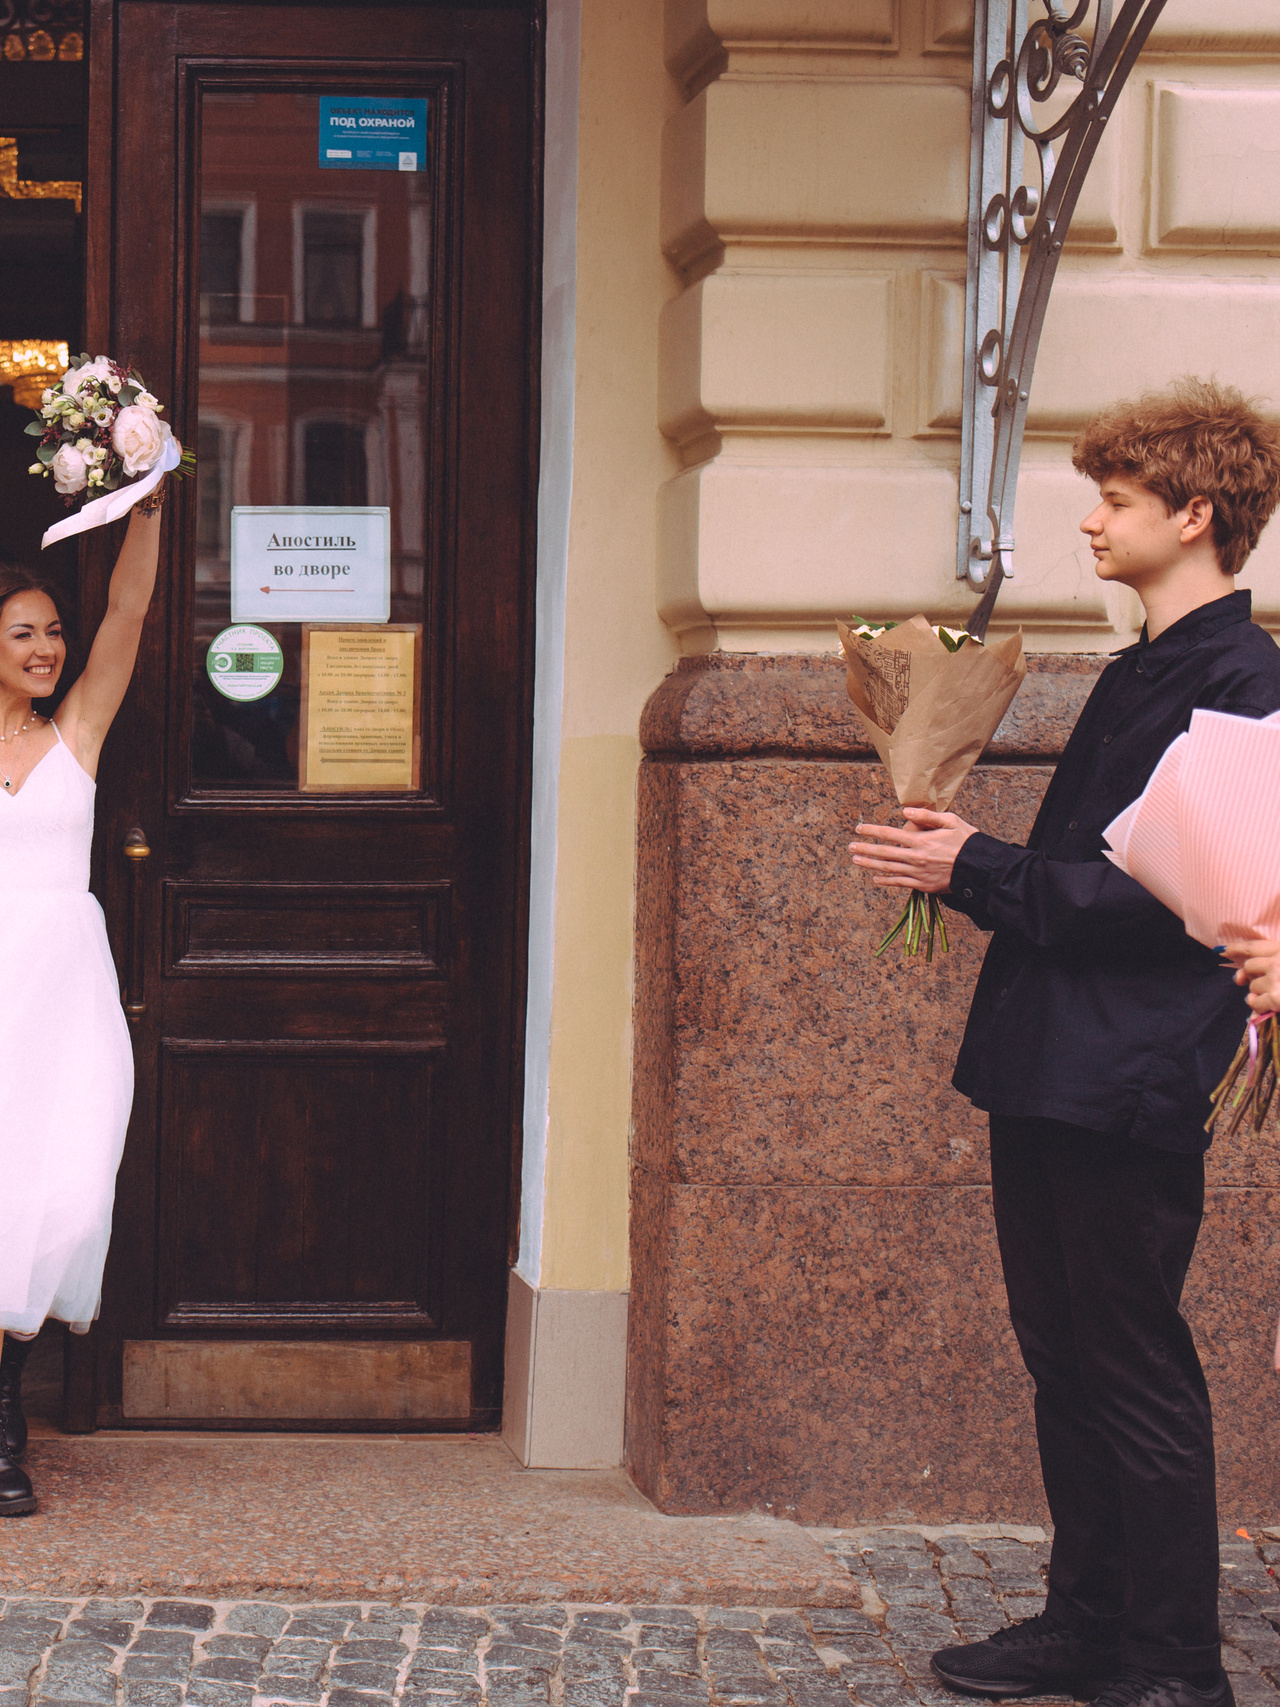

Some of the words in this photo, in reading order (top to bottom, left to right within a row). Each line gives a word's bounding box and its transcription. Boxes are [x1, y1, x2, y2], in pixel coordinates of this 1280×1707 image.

[364, 108, 415, 117] НАХОДИТСЯ
[330, 117, 356, 128] ПОД
[358, 117, 415, 128] ОХРАНОЙ
[267, 533, 356, 549] Апостиль
[274, 565, 294, 576] во
[299, 565, 351, 579] дворе
[214, 629, 247, 650] УЧАСТНИК
[249, 629, 275, 650] ПРОЕКТА
